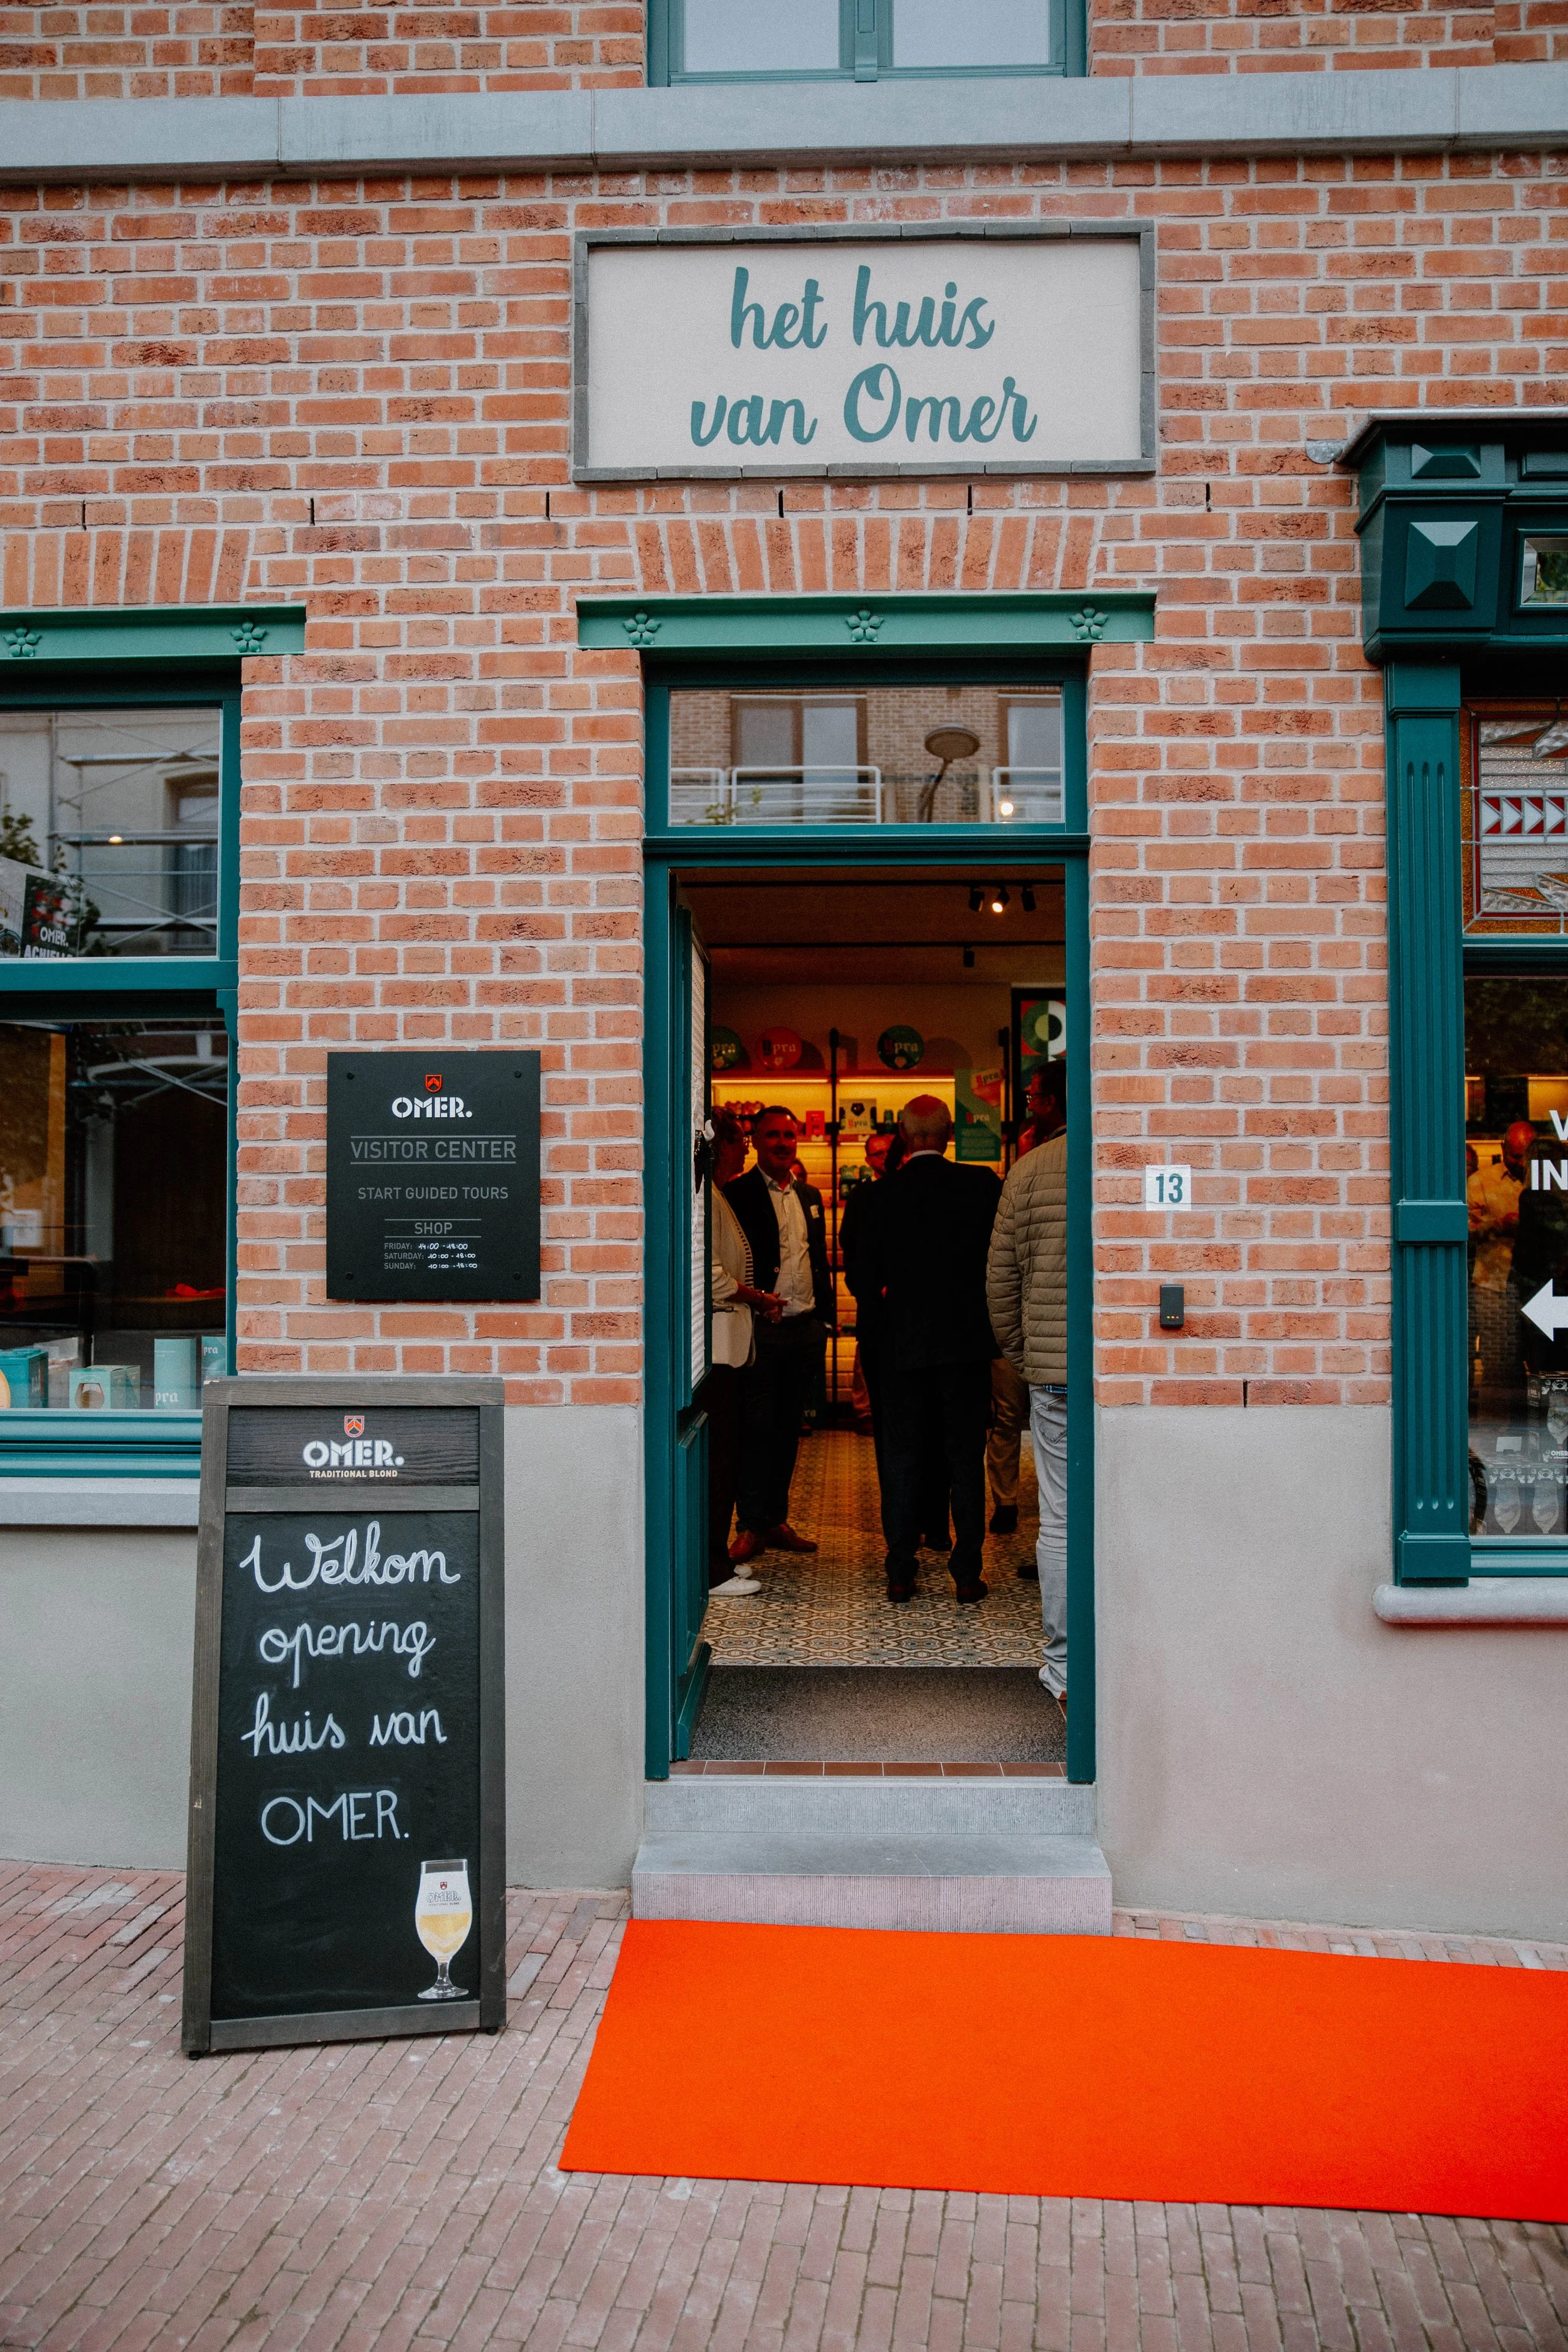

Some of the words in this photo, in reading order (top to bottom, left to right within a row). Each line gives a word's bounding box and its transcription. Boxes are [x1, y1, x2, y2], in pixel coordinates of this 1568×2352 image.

[730, 267, 827, 349] het
[853, 265, 995, 349] huis
[691, 395, 818, 447] van
[844, 363, 1037, 443] Omer
[392, 1097, 472, 1118] OMER.
[351, 1142, 428, 1158] VISITOR
[435, 1140, 516, 1158] CENTER
[358, 1188, 401, 1199] START
[405, 1187, 458, 1199] GUIDED
[462, 1187, 508, 1199] TOURS
[1155, 1173, 1183, 1203] 13
[415, 1222, 452, 1234] SHOP
[303, 1439, 405, 1467] OMER.
[240, 1521, 461, 1592] Welkom
[260, 1619, 436, 1688] opening
[241, 1692, 345, 1756] huis
[370, 1708, 447, 1746] van
[262, 1789, 410, 1846] OMER.
